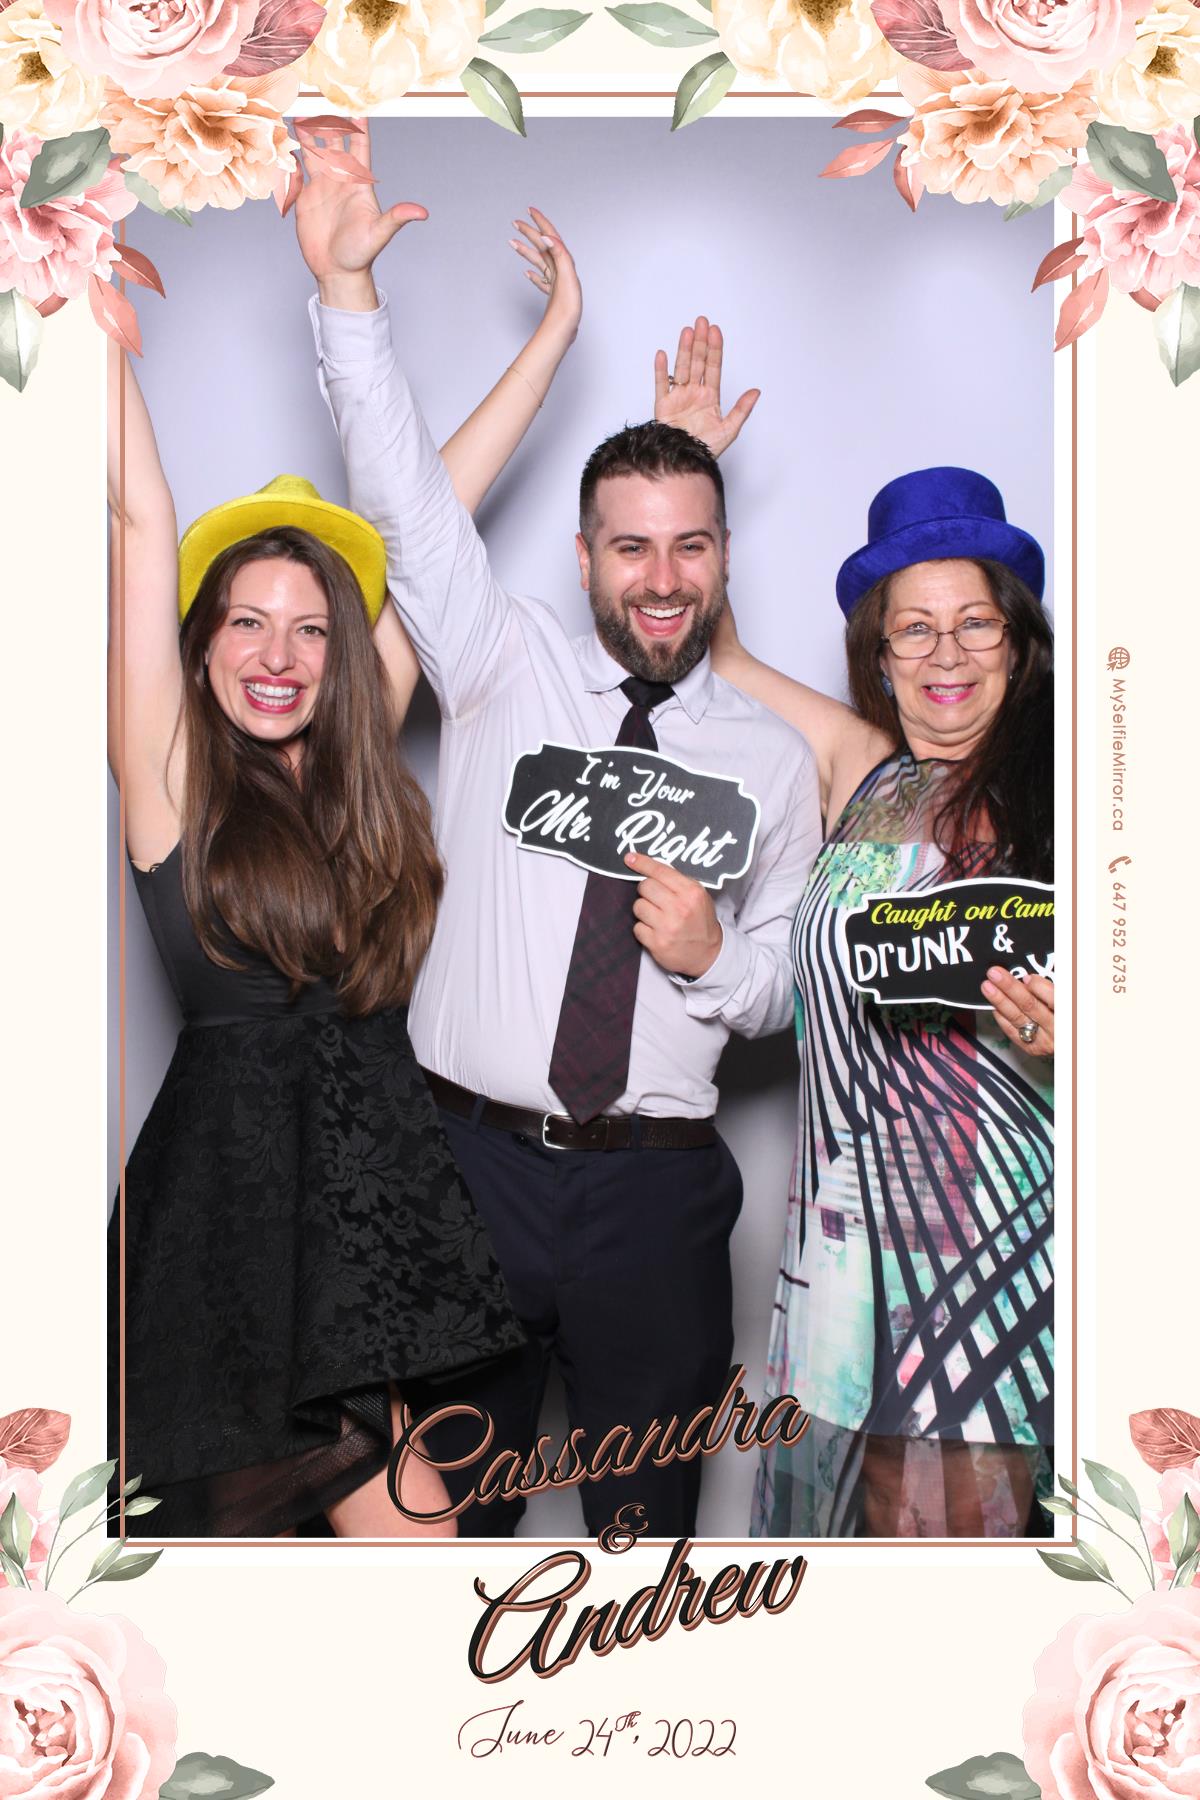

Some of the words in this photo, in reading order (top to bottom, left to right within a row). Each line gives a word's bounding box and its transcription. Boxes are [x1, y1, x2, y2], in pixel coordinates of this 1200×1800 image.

[627, 765, 696, 807] Your
[519, 790, 593, 843] Mr.
[614, 810, 738, 868] Right
[871, 900, 957, 931] Caught
[964, 905, 998, 921] on
[1000, 896, 1055, 919] Cam
[992, 923, 1015, 953] &
